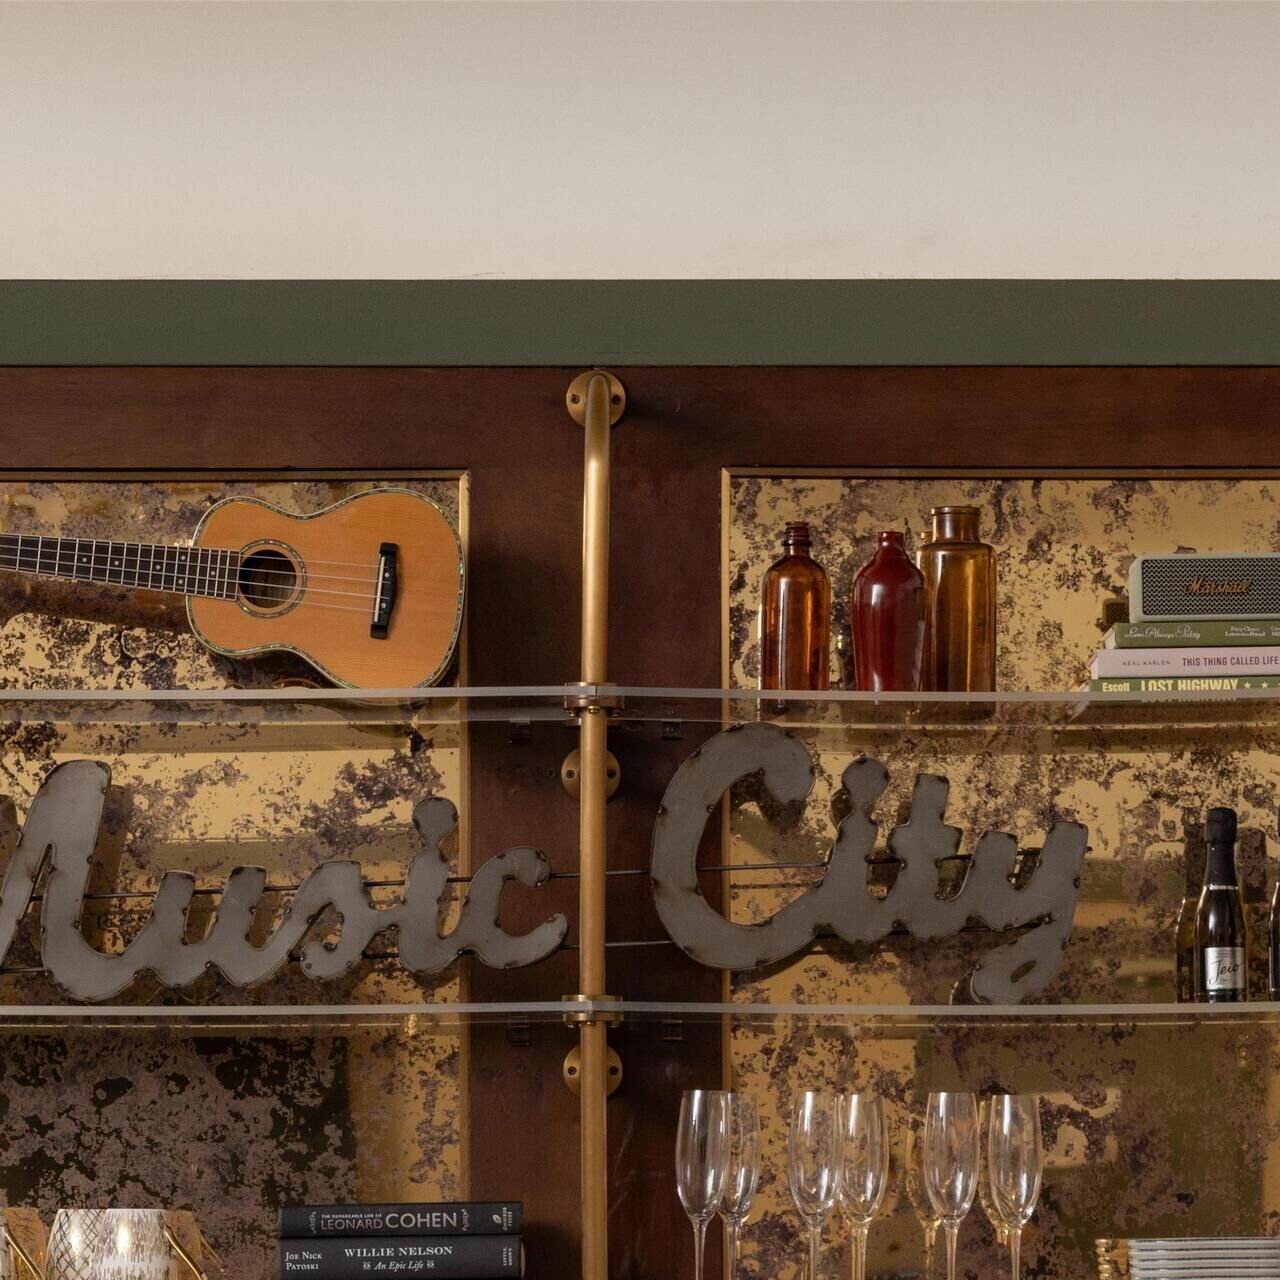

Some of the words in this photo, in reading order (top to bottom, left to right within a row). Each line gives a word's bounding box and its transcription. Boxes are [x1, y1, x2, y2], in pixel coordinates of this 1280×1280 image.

[1186, 575, 1252, 594] Marshall
[1182, 657, 1202, 667] THIS
[1203, 657, 1228, 667] THING
[1230, 656, 1260, 666] CALLED
[1262, 656, 1280, 665] LIFE
[1141, 679, 1174, 692] LOST
[1177, 678, 1239, 691] HIGHWAY
[650, 721, 1089, 1005] City
[1208, 958, 1246, 985] Jeio
[321, 1219, 383, 1230] LEONARD
[385, 1212, 457, 1229] COHEN
[344, 1247, 395, 1257] WILLIE
[398, 1246, 453, 1256] NELSON
[374, 1261, 387, 1270] An
[388, 1261, 406, 1272] Epic
[408, 1260, 424, 1272] Life
